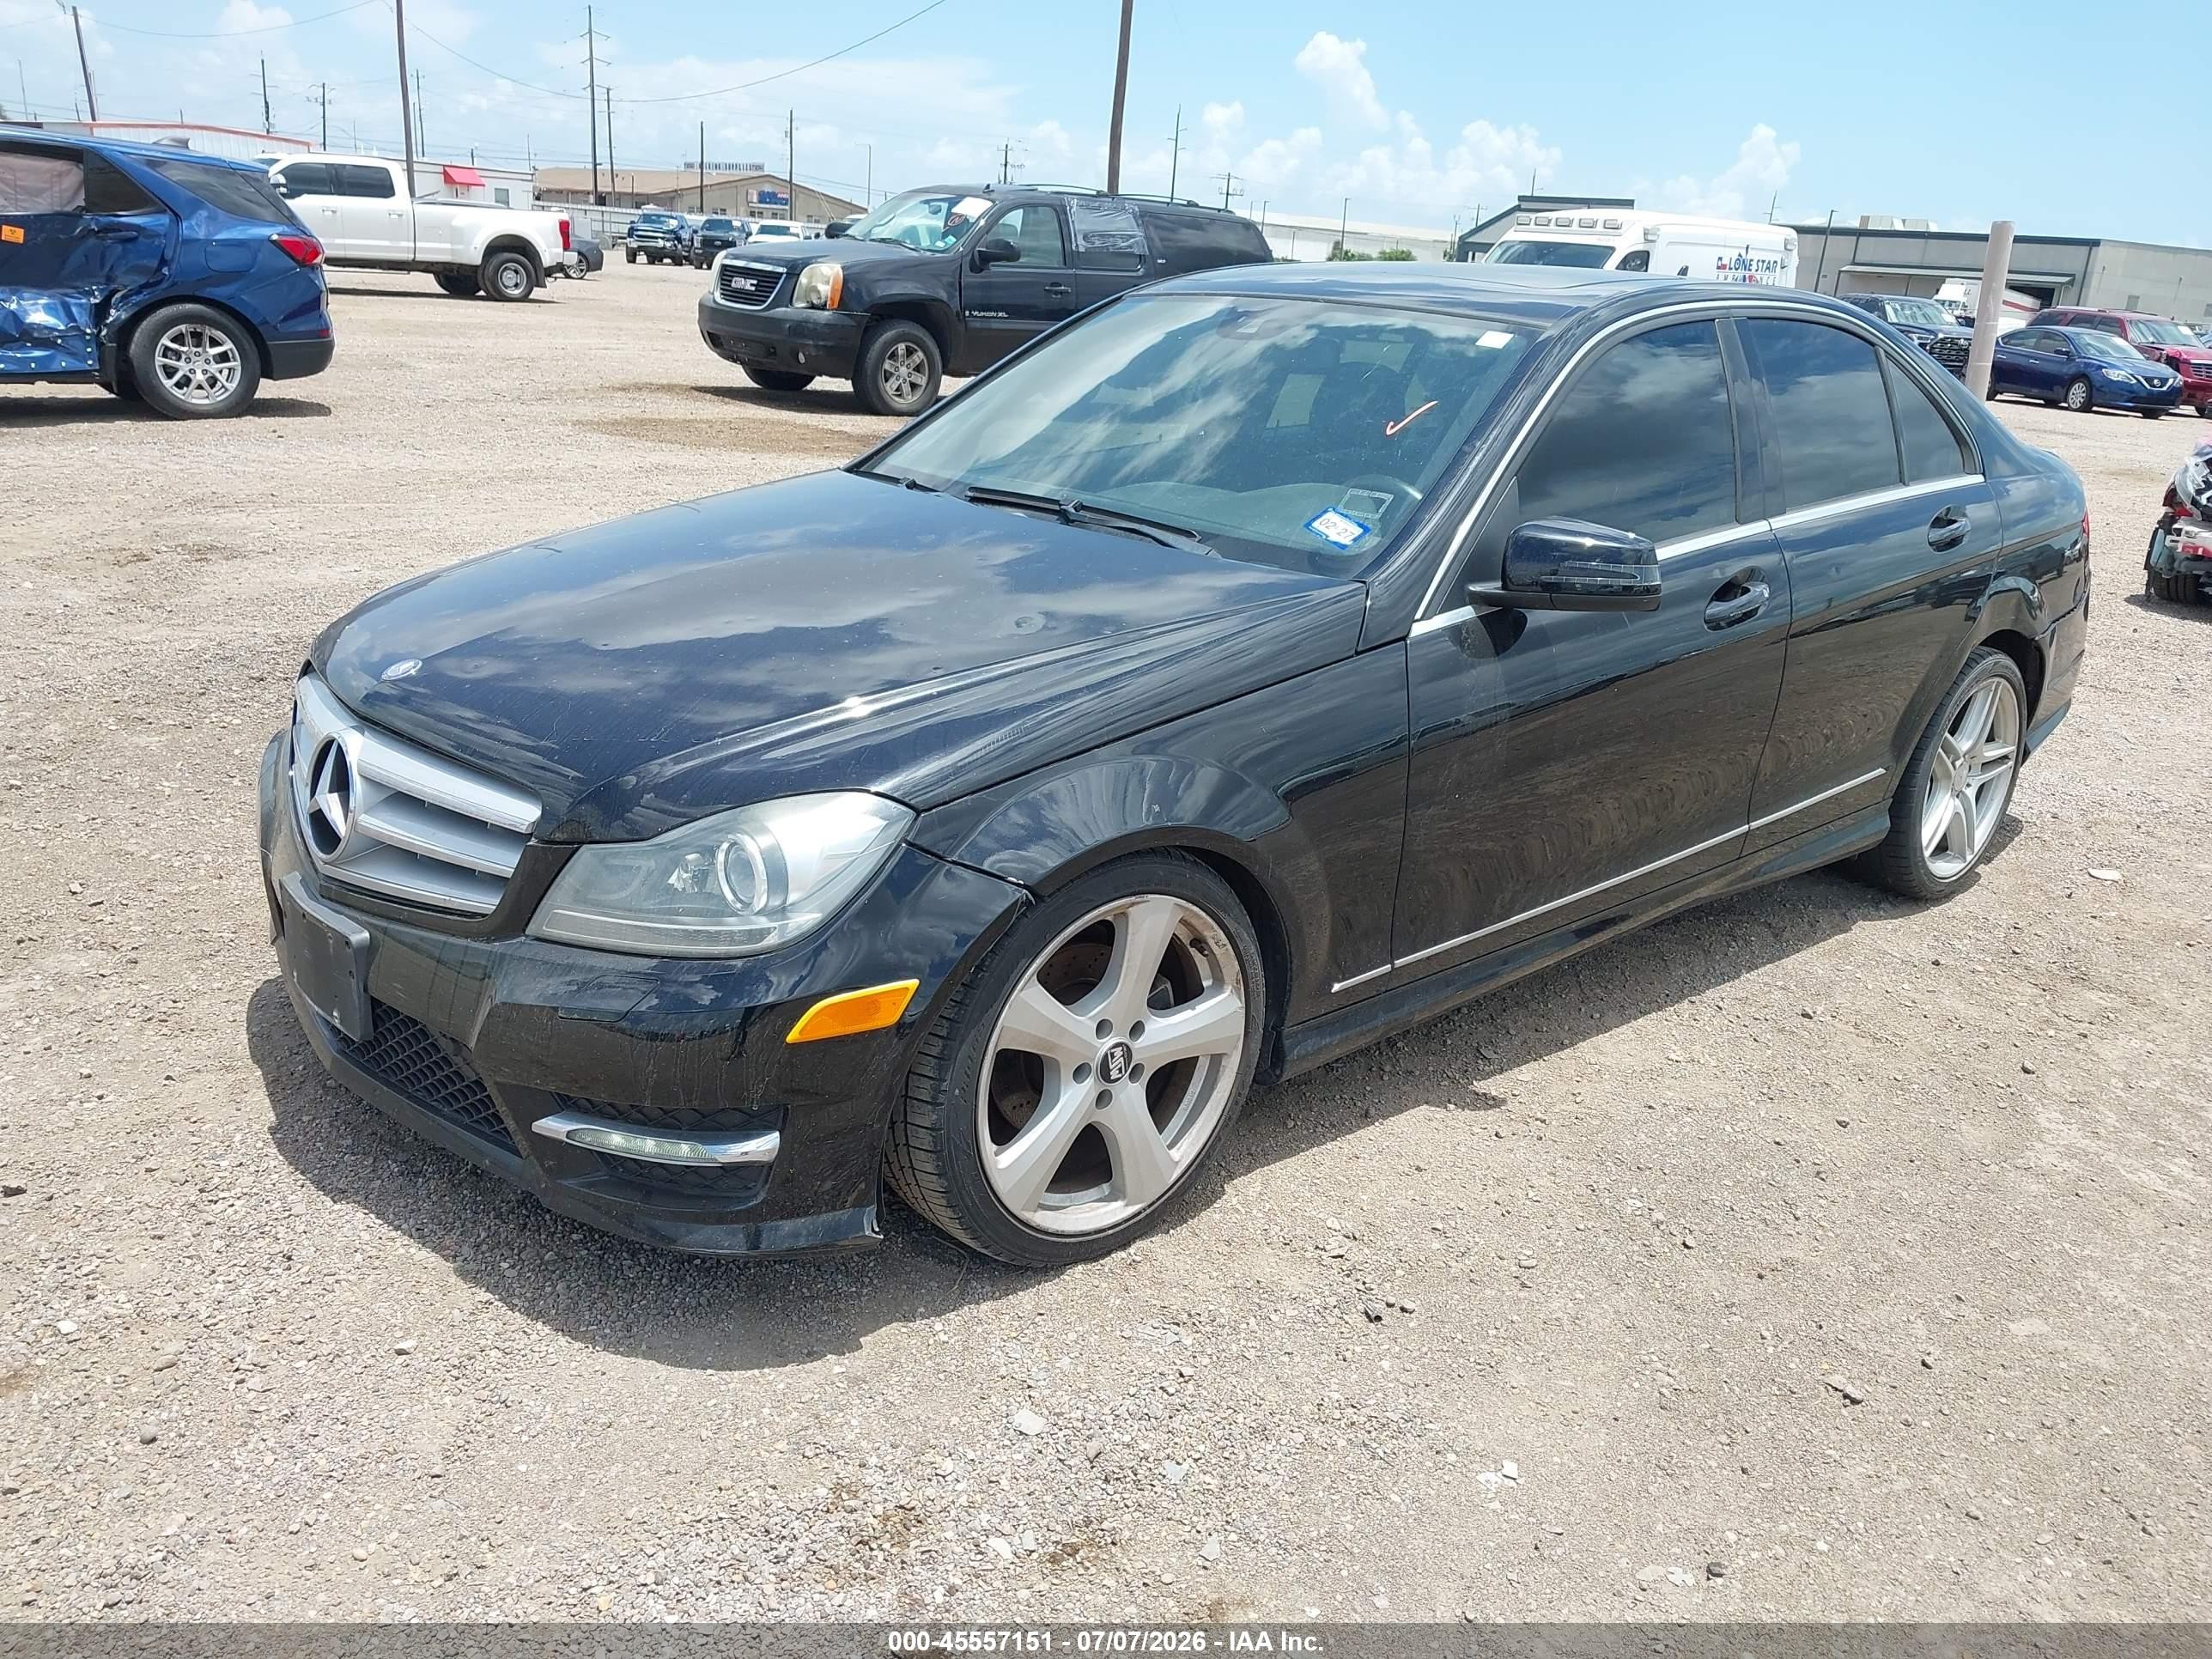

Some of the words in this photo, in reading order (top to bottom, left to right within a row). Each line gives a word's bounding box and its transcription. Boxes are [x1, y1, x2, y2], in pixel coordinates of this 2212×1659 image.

[1729, 257, 1753, 272] LONE
[1755, 258, 1778, 274] STAR
[731, 276, 758, 291] GMC
